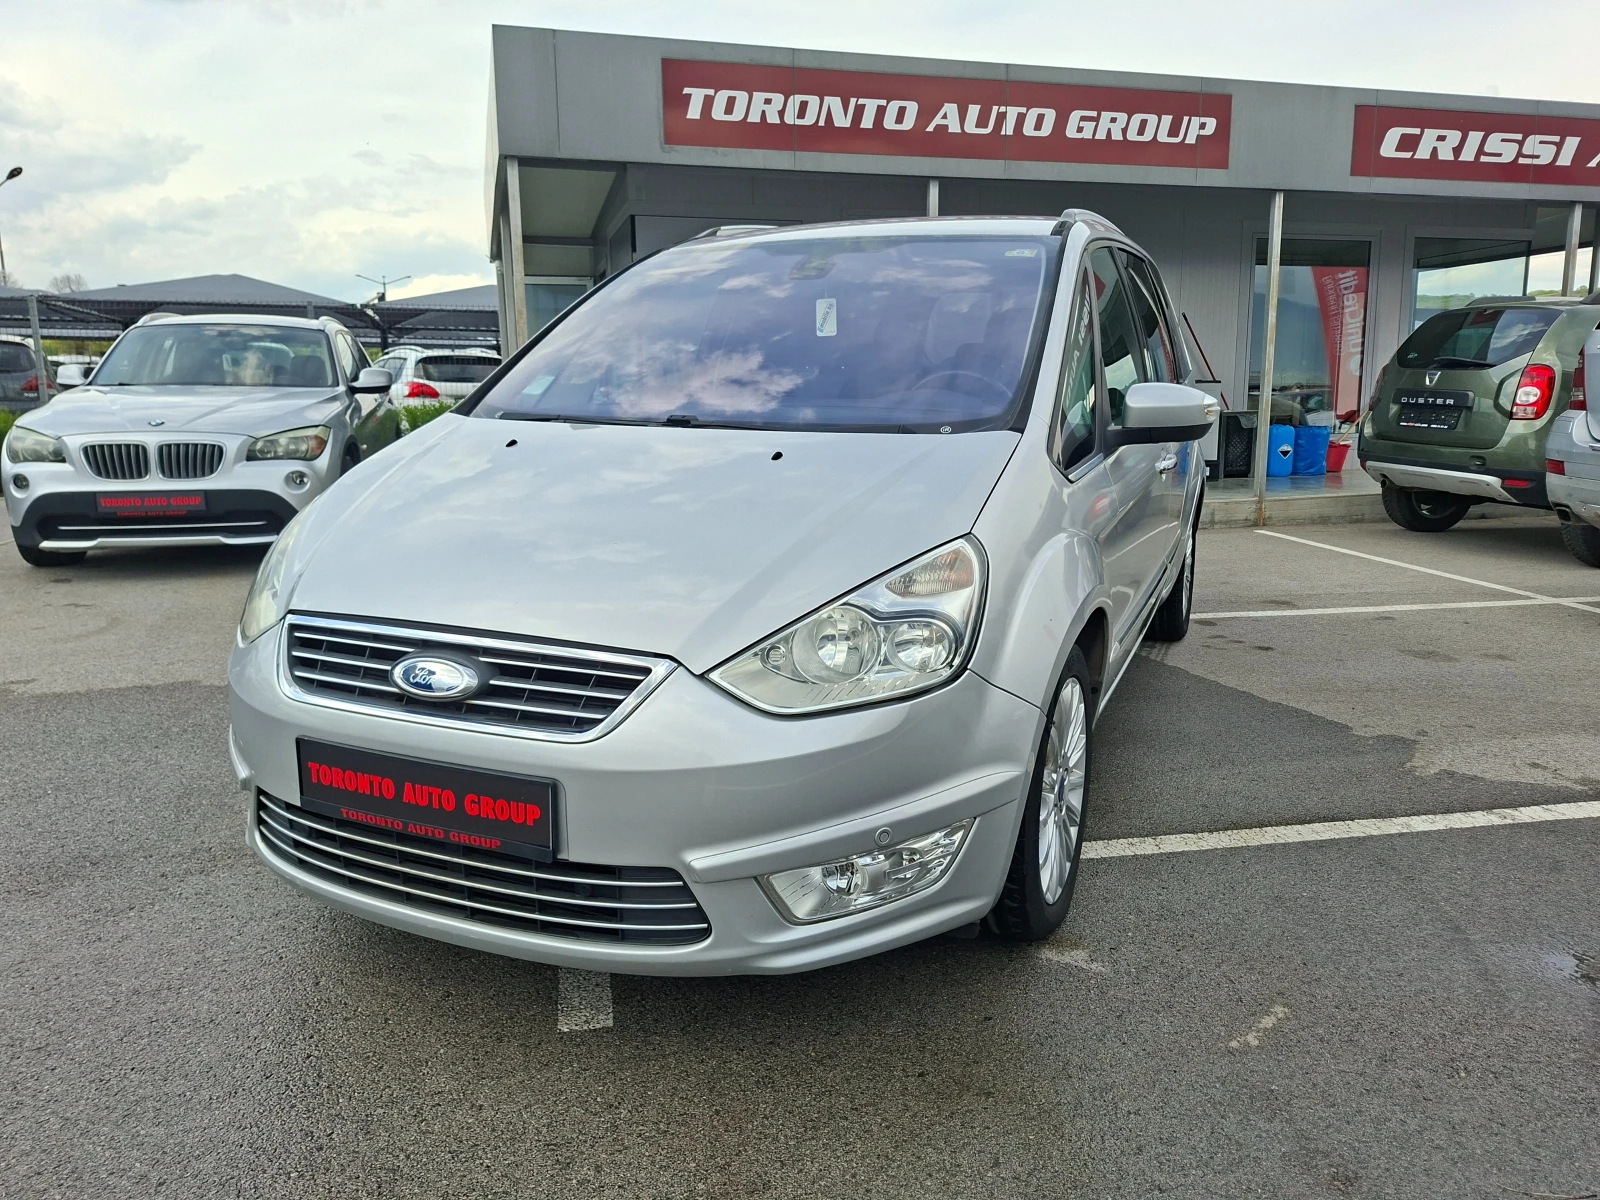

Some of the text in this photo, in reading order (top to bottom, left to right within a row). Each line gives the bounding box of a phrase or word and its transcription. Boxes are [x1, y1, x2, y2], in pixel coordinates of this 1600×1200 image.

[682, 87, 1217, 144] TORONTO AUTO GROUP
[1379, 126, 1582, 166] CRISSI
[1401, 397, 1455, 405] DUSTER
[100, 496, 202, 507] TORONTO AUTO GROUP
[308, 761, 541, 826] TORONTO AUTO GROUP
[340, 807, 502, 849] TORONTO AUTO GROUP
